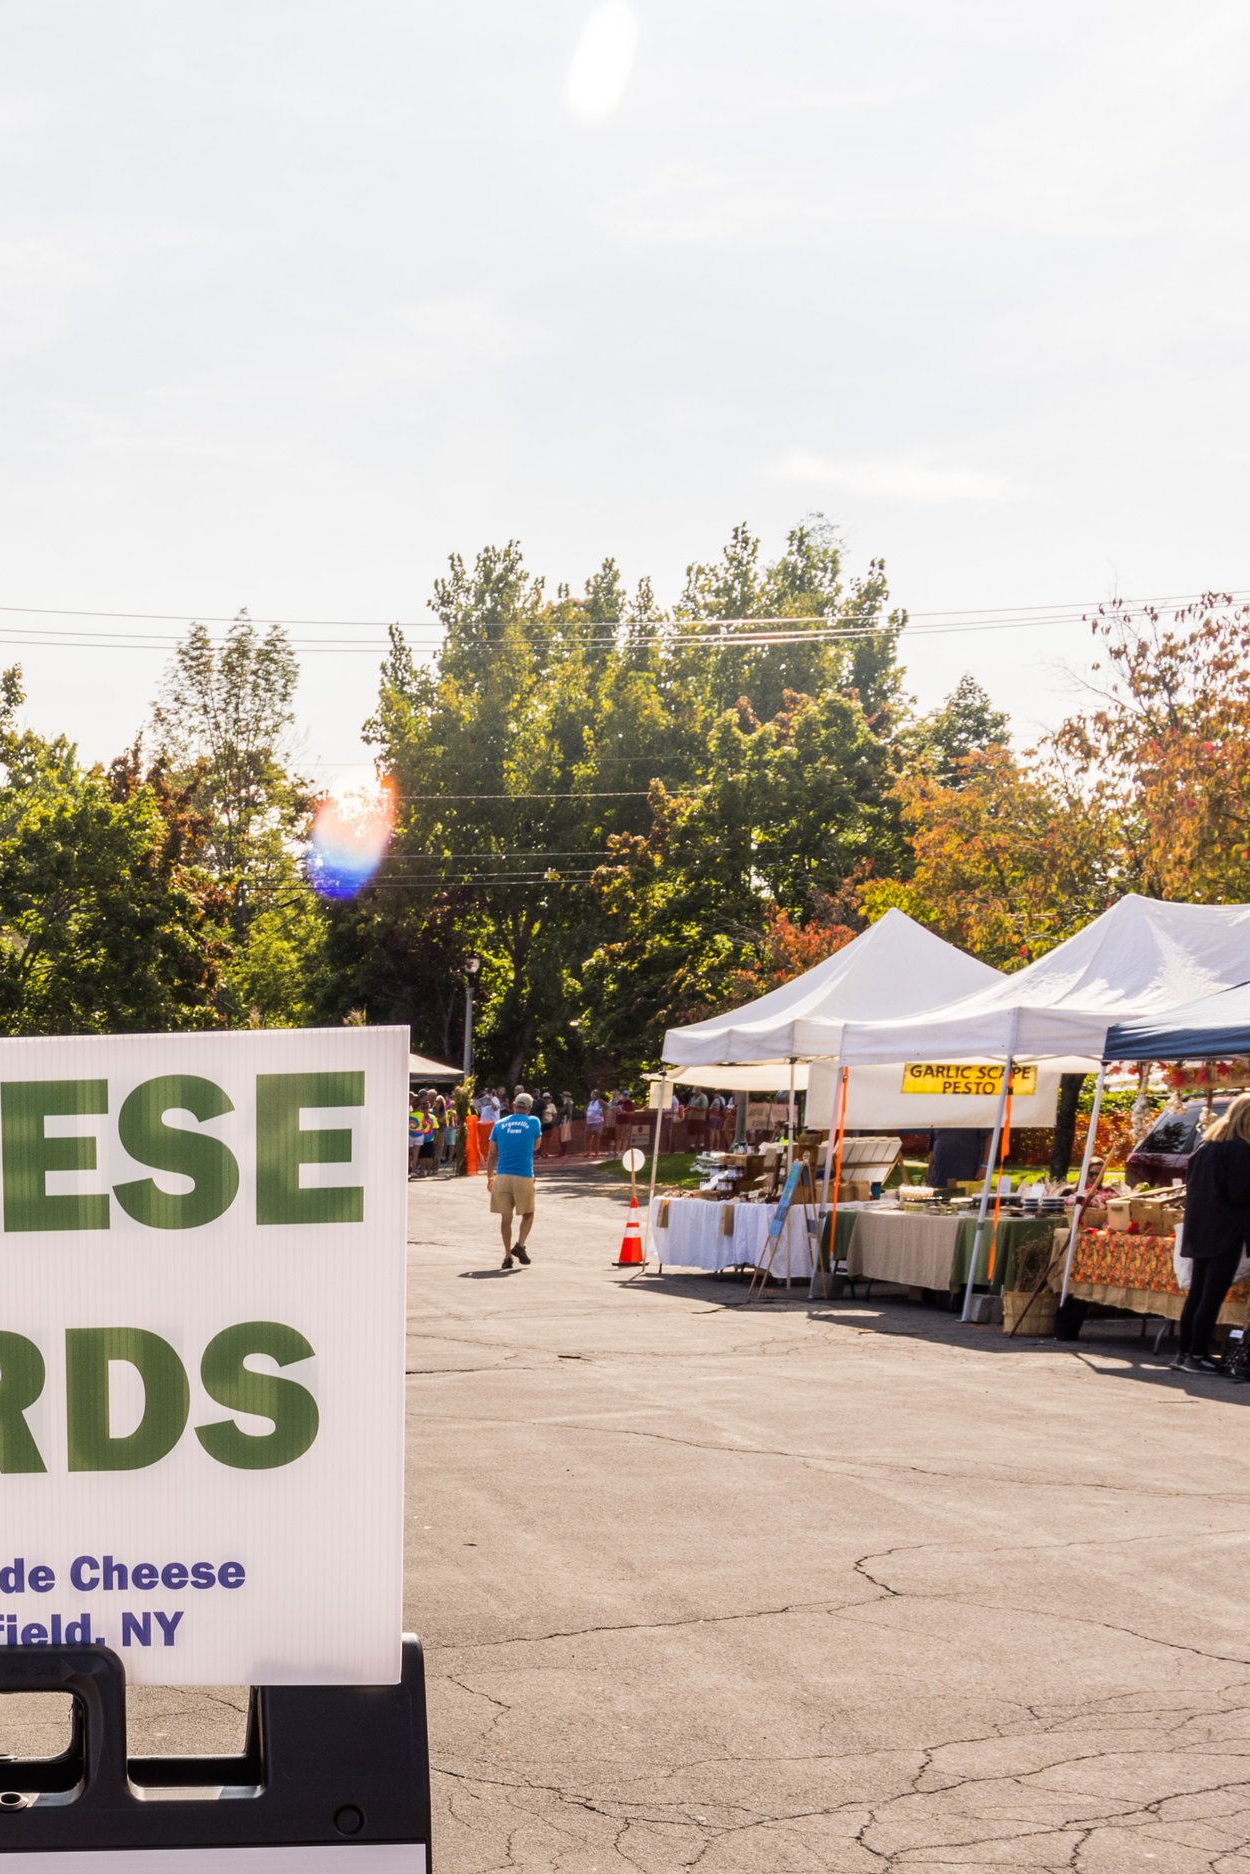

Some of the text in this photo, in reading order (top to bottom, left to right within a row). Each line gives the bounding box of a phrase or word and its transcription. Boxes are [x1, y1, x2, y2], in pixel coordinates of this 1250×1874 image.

[910, 1065, 972, 1079] GARLIC
[942, 1081, 996, 1095] PESTO
[69, 1555, 246, 1592] Cheese
[121, 1611, 185, 1647] NY
